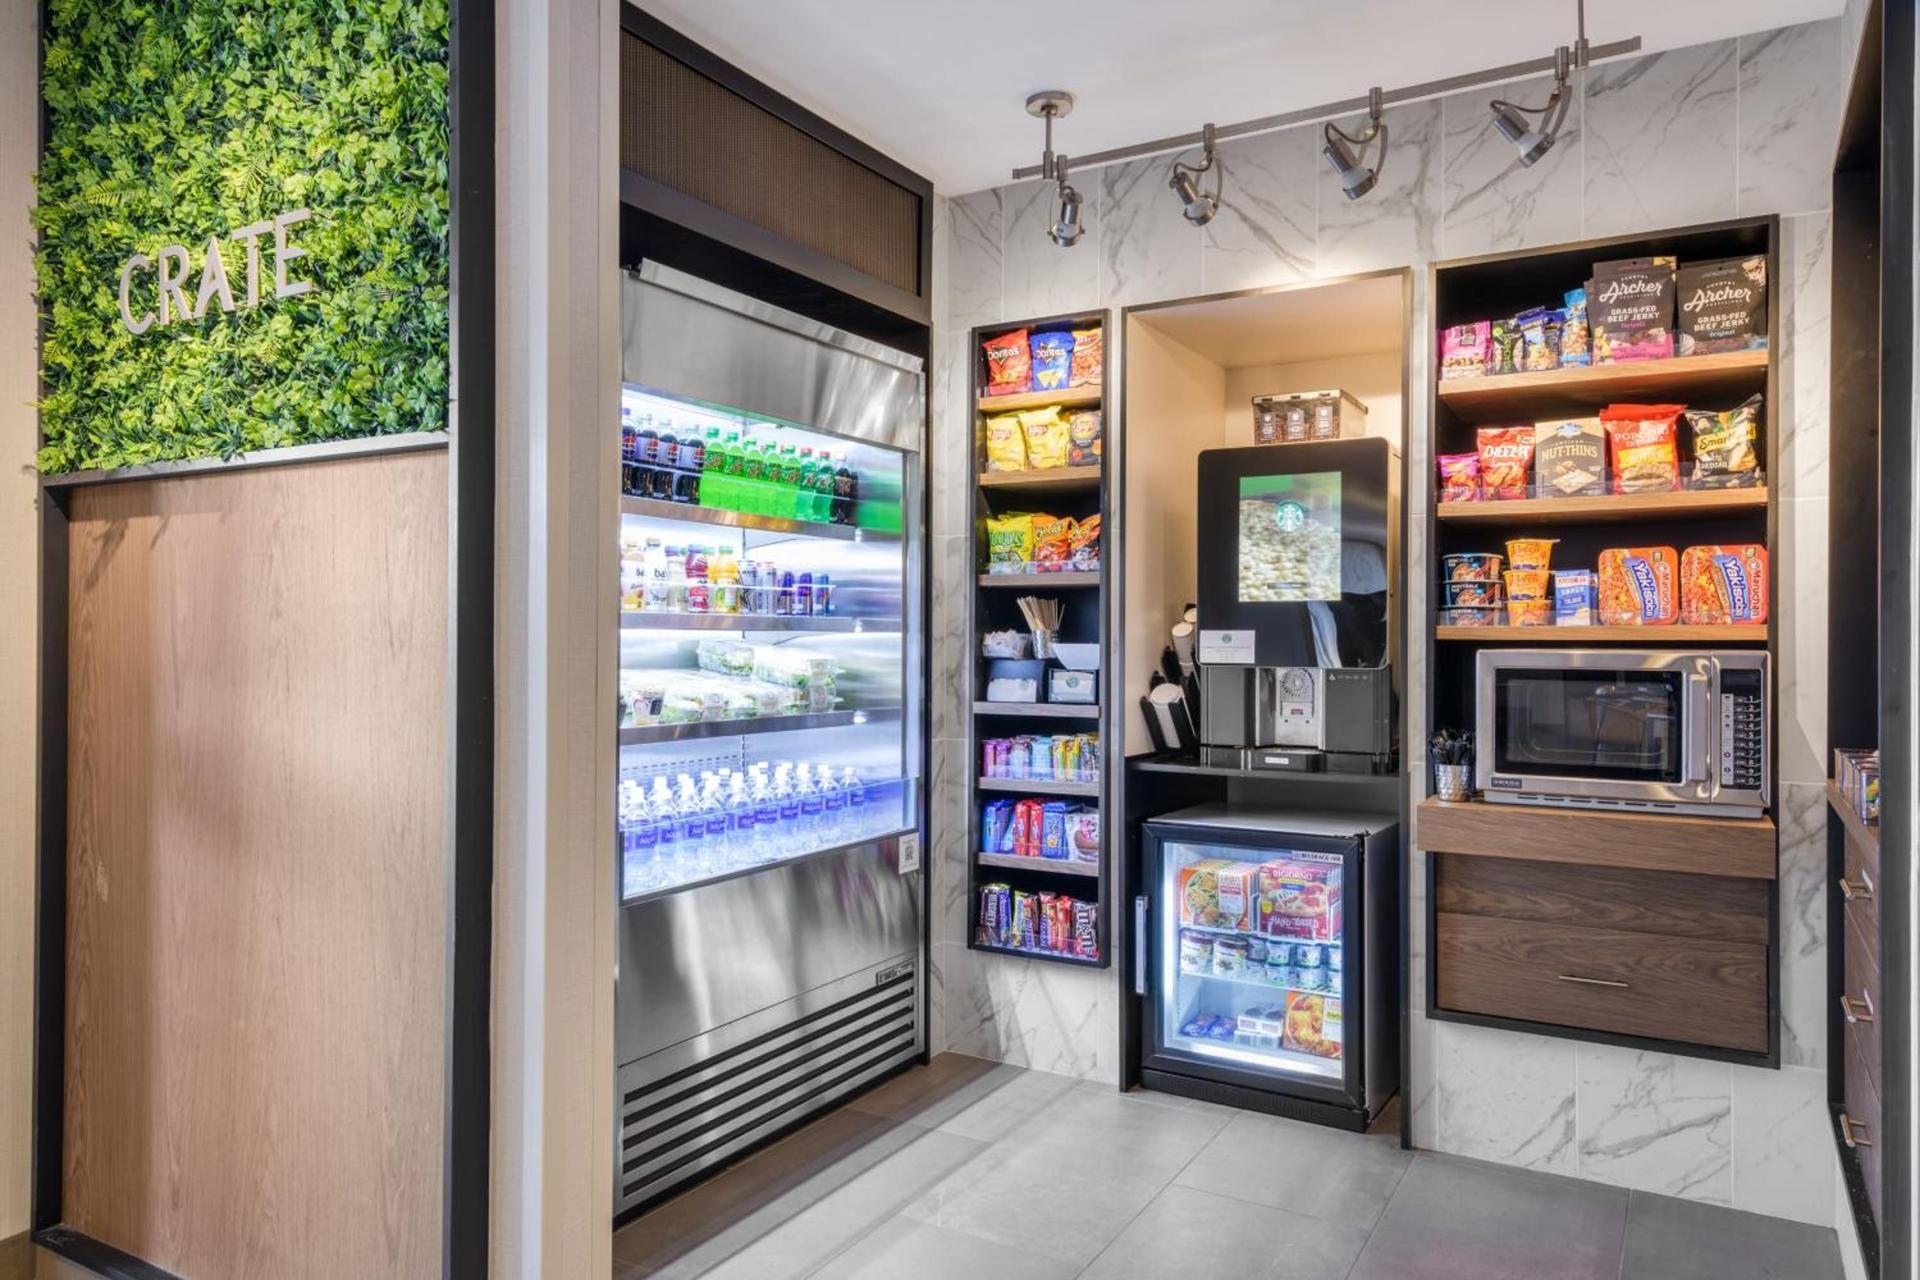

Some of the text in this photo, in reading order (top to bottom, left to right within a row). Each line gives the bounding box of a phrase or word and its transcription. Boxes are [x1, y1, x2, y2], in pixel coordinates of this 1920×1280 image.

[119, 208, 313, 335] CRATE
[1599, 278, 1662, 303] Archer
[1683, 285, 1751, 312] Archer
[1608, 311, 1660, 322] BEEF JERKY
[1610, 305, 1657, 315] GRASS-FED
[1697, 312, 1747, 324] GRASS-FED
[1694, 318, 1750, 332] BEEF JERKY
[1632, 560, 1657, 618] Yakisoba
[1660, 573, 1671, 617] Maruchan
[1723, 556, 1748, 618] Yakisoba
[1750, 569, 1763, 617] Maruchan
